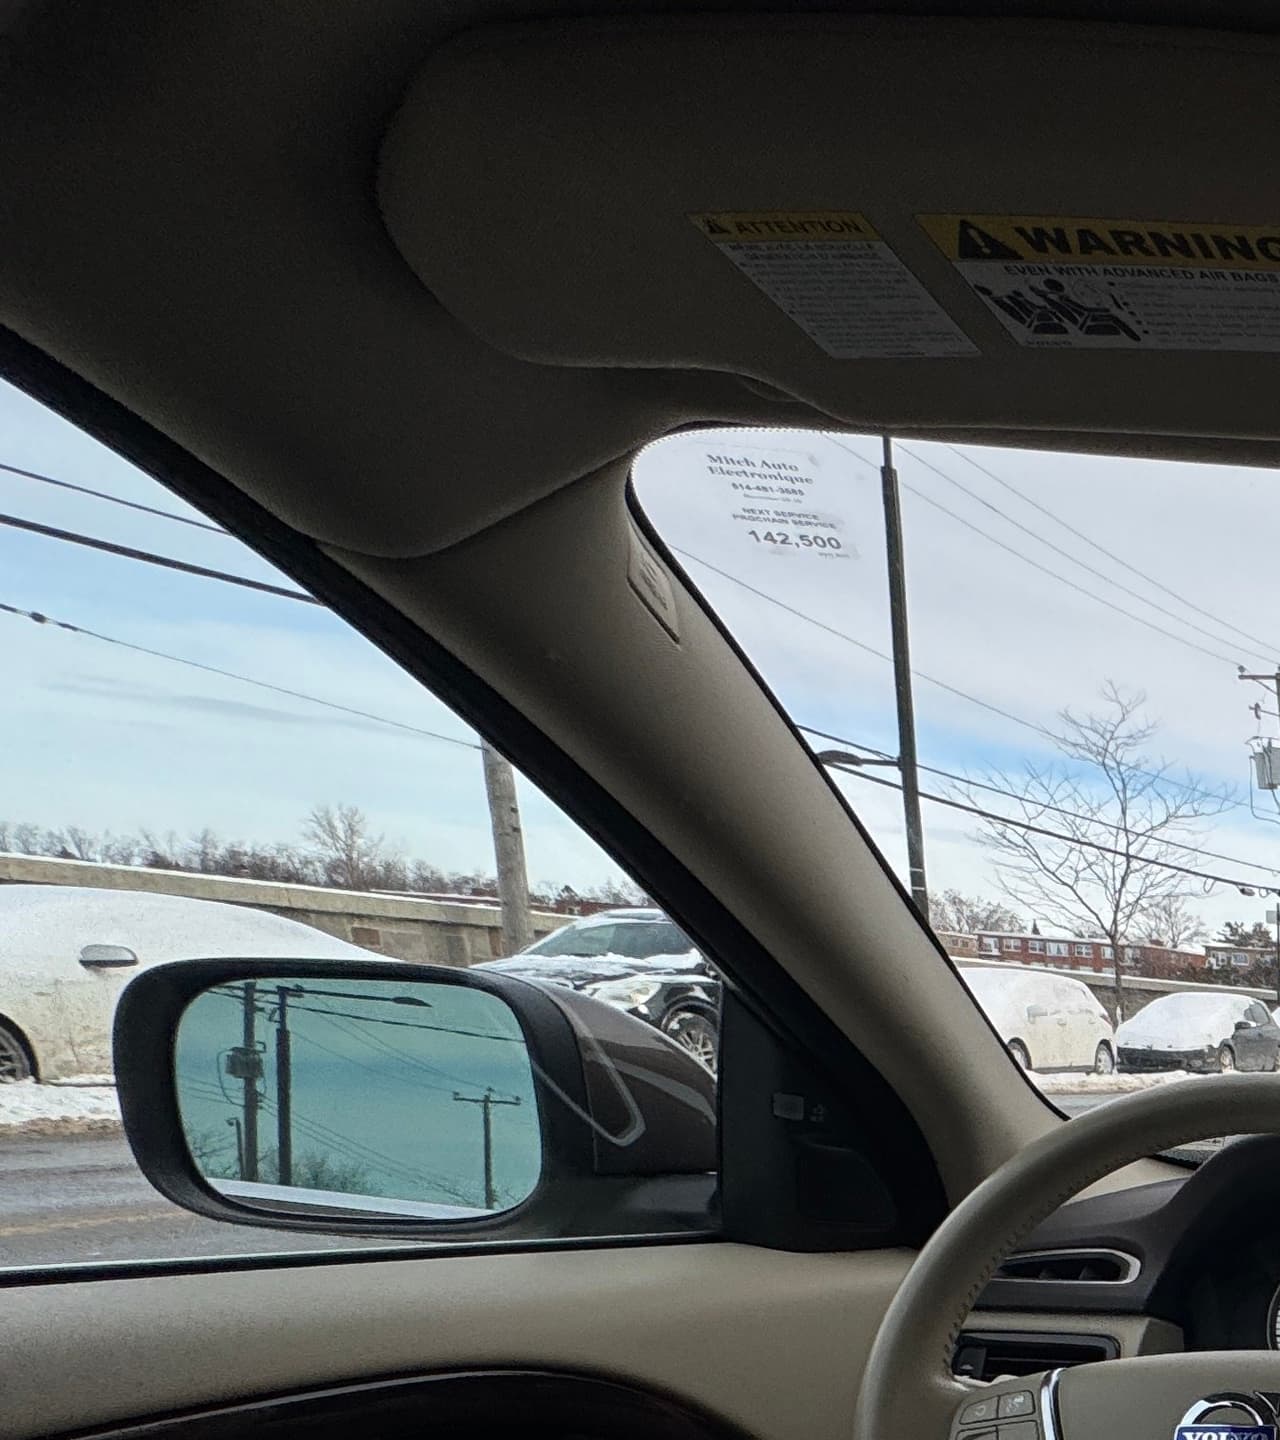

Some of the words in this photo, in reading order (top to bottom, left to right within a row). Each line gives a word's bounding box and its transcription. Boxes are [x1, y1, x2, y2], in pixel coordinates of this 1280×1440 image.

[734, 220, 864, 235] ATTENTION
[1004, 264, 1054, 276] EVEN
[1055, 265, 1101, 278] WITH
[1102, 266, 1194, 281] ADVANCED
[1199, 269, 1227, 281] AIR
[1230, 270, 1279, 284] BAGS
[706, 453, 757, 469] Mitch
[759, 459, 801, 472] Auto
[706, 465, 815, 485] Electronique
[741, 506, 771, 516] NEXT
[773, 509, 820, 522] SERVICE
[791, 518, 838, 530] SERVICE
[747, 529, 842, 550] 142,500
